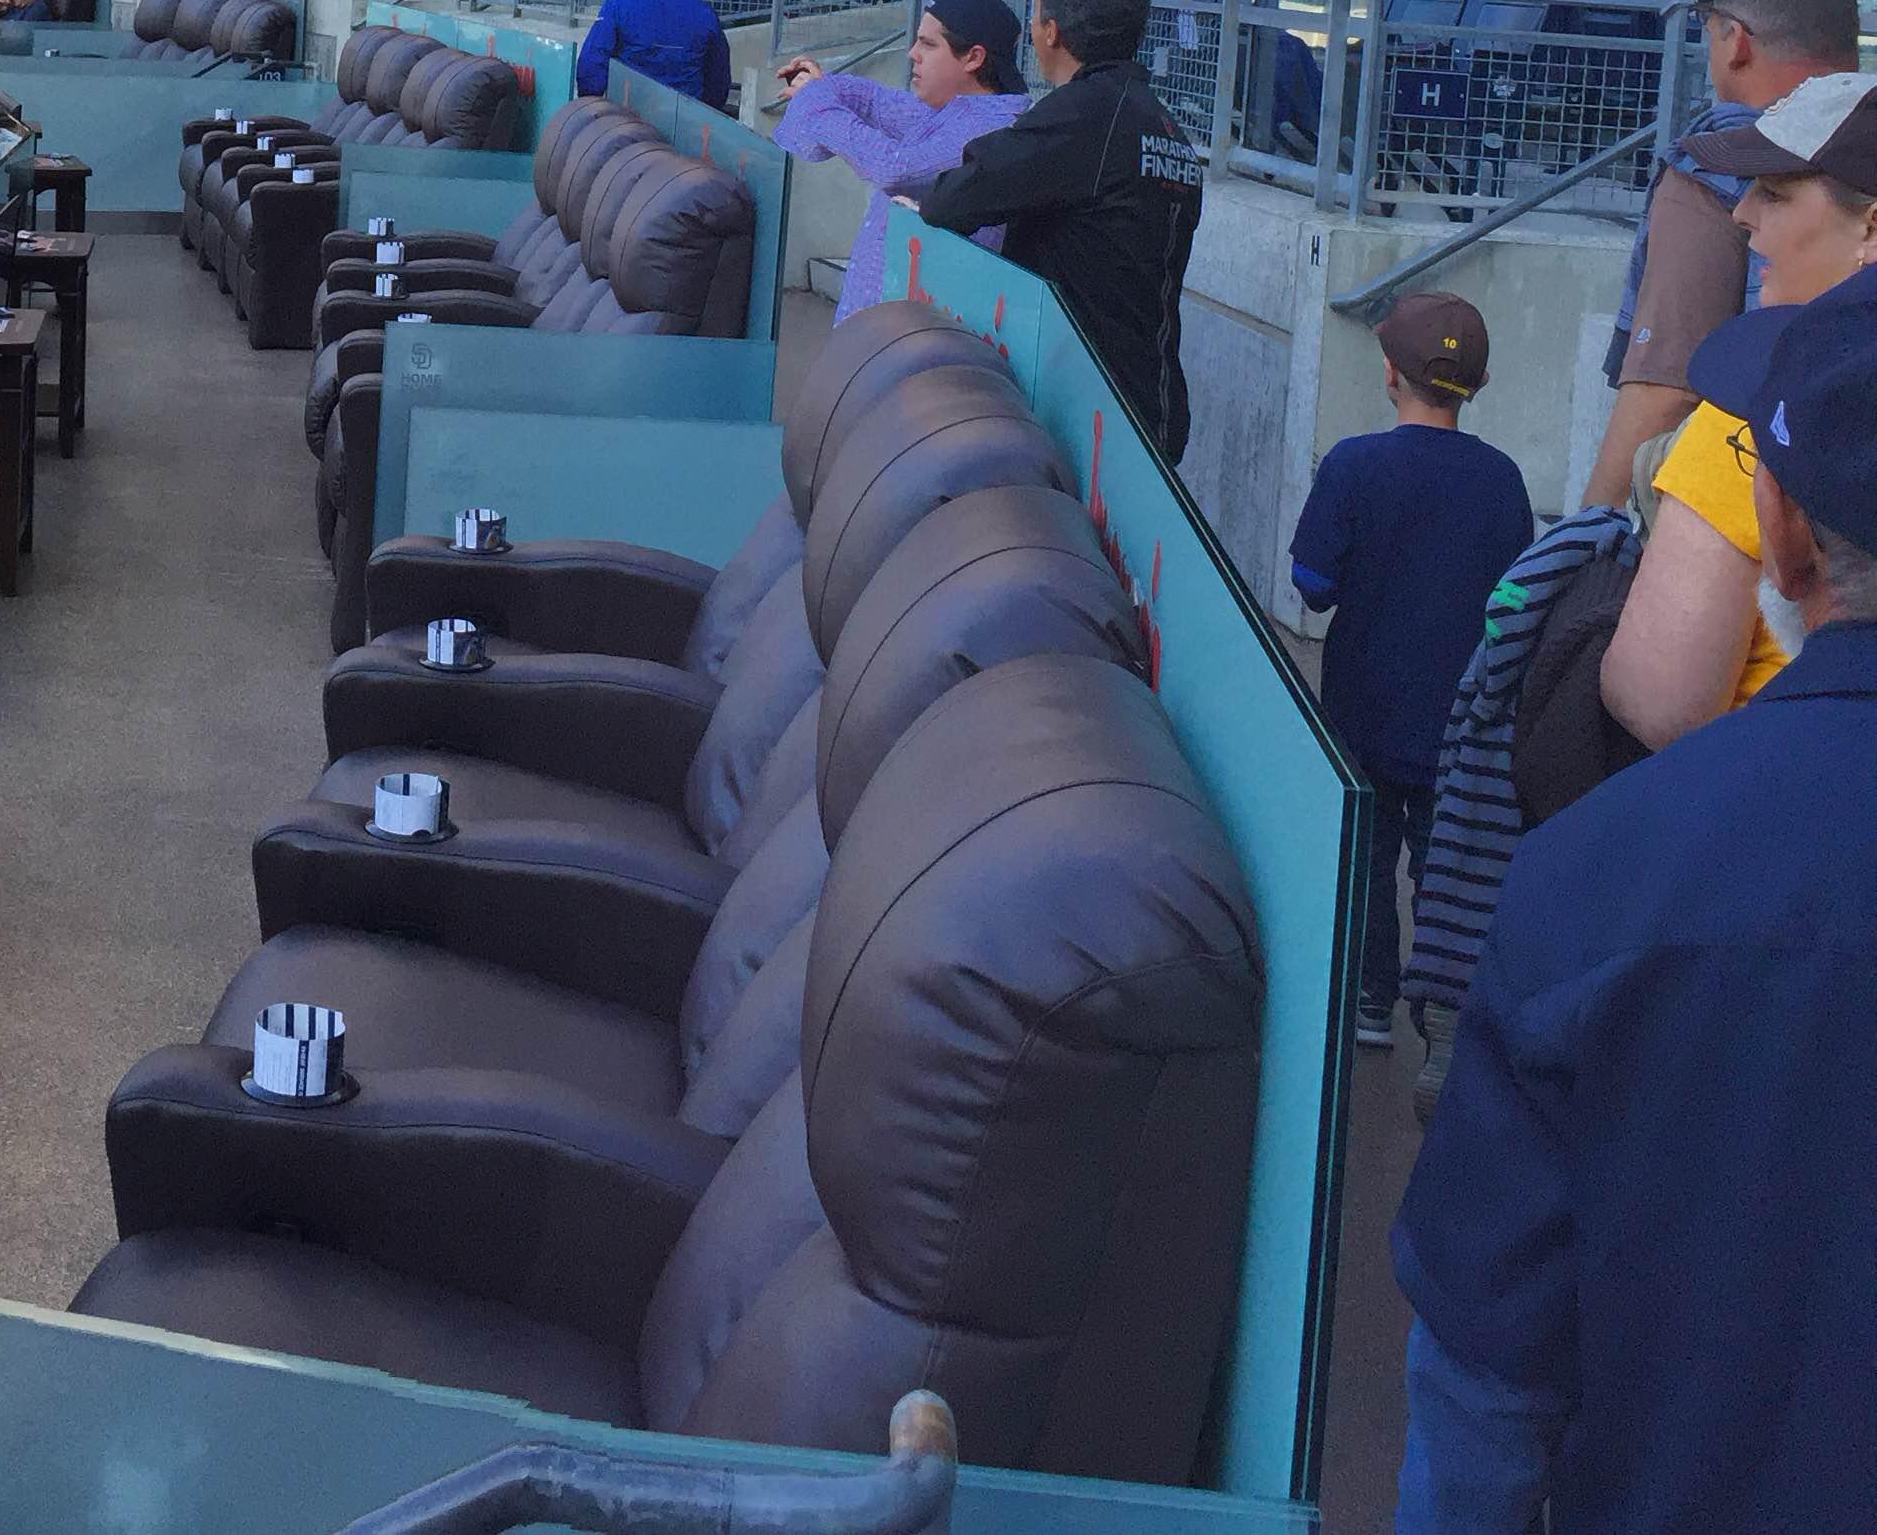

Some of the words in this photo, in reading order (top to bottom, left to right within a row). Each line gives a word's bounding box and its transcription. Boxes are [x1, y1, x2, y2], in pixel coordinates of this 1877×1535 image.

[1421, 82, 1441, 107] H
[1310, 235, 1320, 266] H
[1442, 336, 1457, 350] 10
[402, 373, 443, 385] HOME
